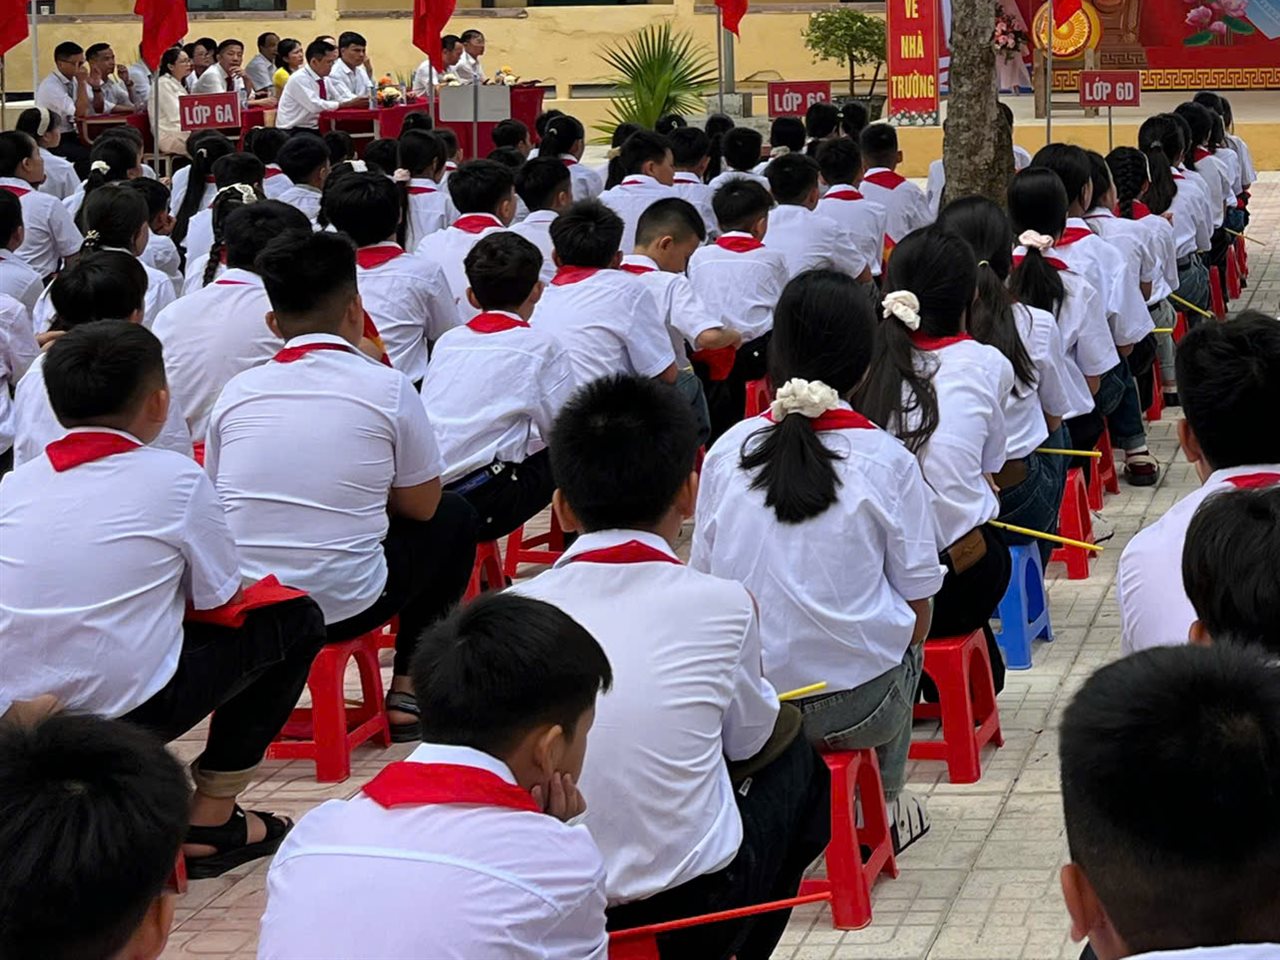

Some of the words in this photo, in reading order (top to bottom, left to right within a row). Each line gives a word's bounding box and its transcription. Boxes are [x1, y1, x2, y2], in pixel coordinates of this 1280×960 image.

[901, 30, 925, 59] NHÀ
[891, 70, 935, 99] TRƯỜNG
[1085, 76, 1111, 101] LỚP
[1116, 82, 1134, 101] 6D
[184, 100, 211, 125] LỚP
[215, 104, 234, 123] 6A
[774, 88, 802, 112] LỚP
